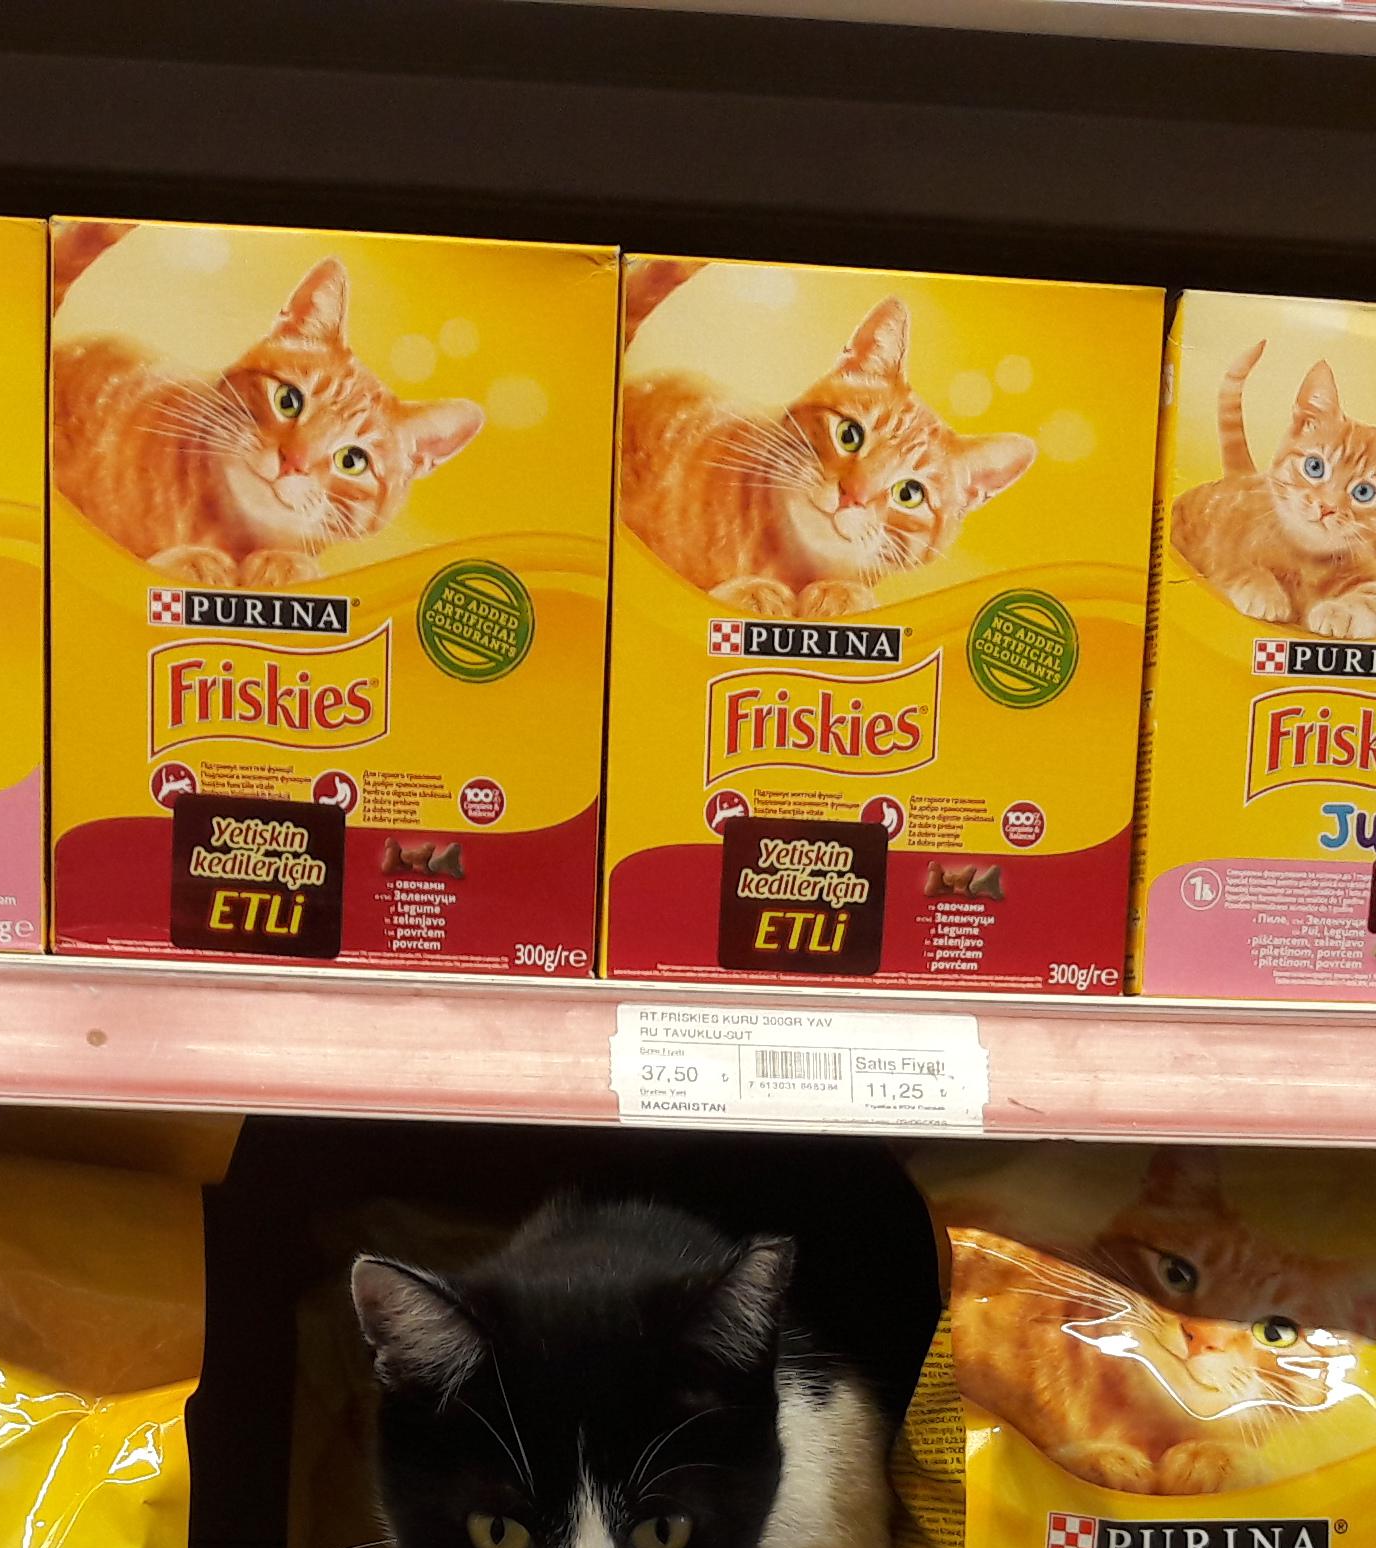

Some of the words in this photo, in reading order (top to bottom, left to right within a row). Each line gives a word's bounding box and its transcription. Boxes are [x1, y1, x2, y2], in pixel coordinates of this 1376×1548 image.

[191, 596, 342, 631] PURINA
[433, 600, 516, 644] ARTIFICIAL
[443, 588, 465, 605] NO
[467, 600, 518, 630] ADDED
[426, 610, 516, 658] COLOURANTS
[750, 631, 896, 659] PURINA
[981, 627, 1063, 670] ARTIFICIAL
[991, 616, 1015, 635] NO
[1016, 624, 1065, 658] ADDED
[974, 638, 1063, 686] COLOURANTS
[168, 657, 372, 732] Friskies
[725, 689, 922, 758] Friskies
[212, 818, 308, 855] Yetişkin
[191, 847, 277, 881] kediler
[279, 853, 326, 890] için
[758, 839, 853, 872] Yetişkin
[737, 869, 820, 900] kediler
[823, 875, 868, 909] için
[397, 904, 441, 915] Legume
[937, 926, 979, 937] Legume
[640, 1027, 657, 1036] RU
[723, 1015, 758, 1025] KURU
[641, 1065, 698, 1084] 37,50
[866, 1082, 924, 1101] 11,25
[640, 1100, 726, 1113] MACARISTAN
